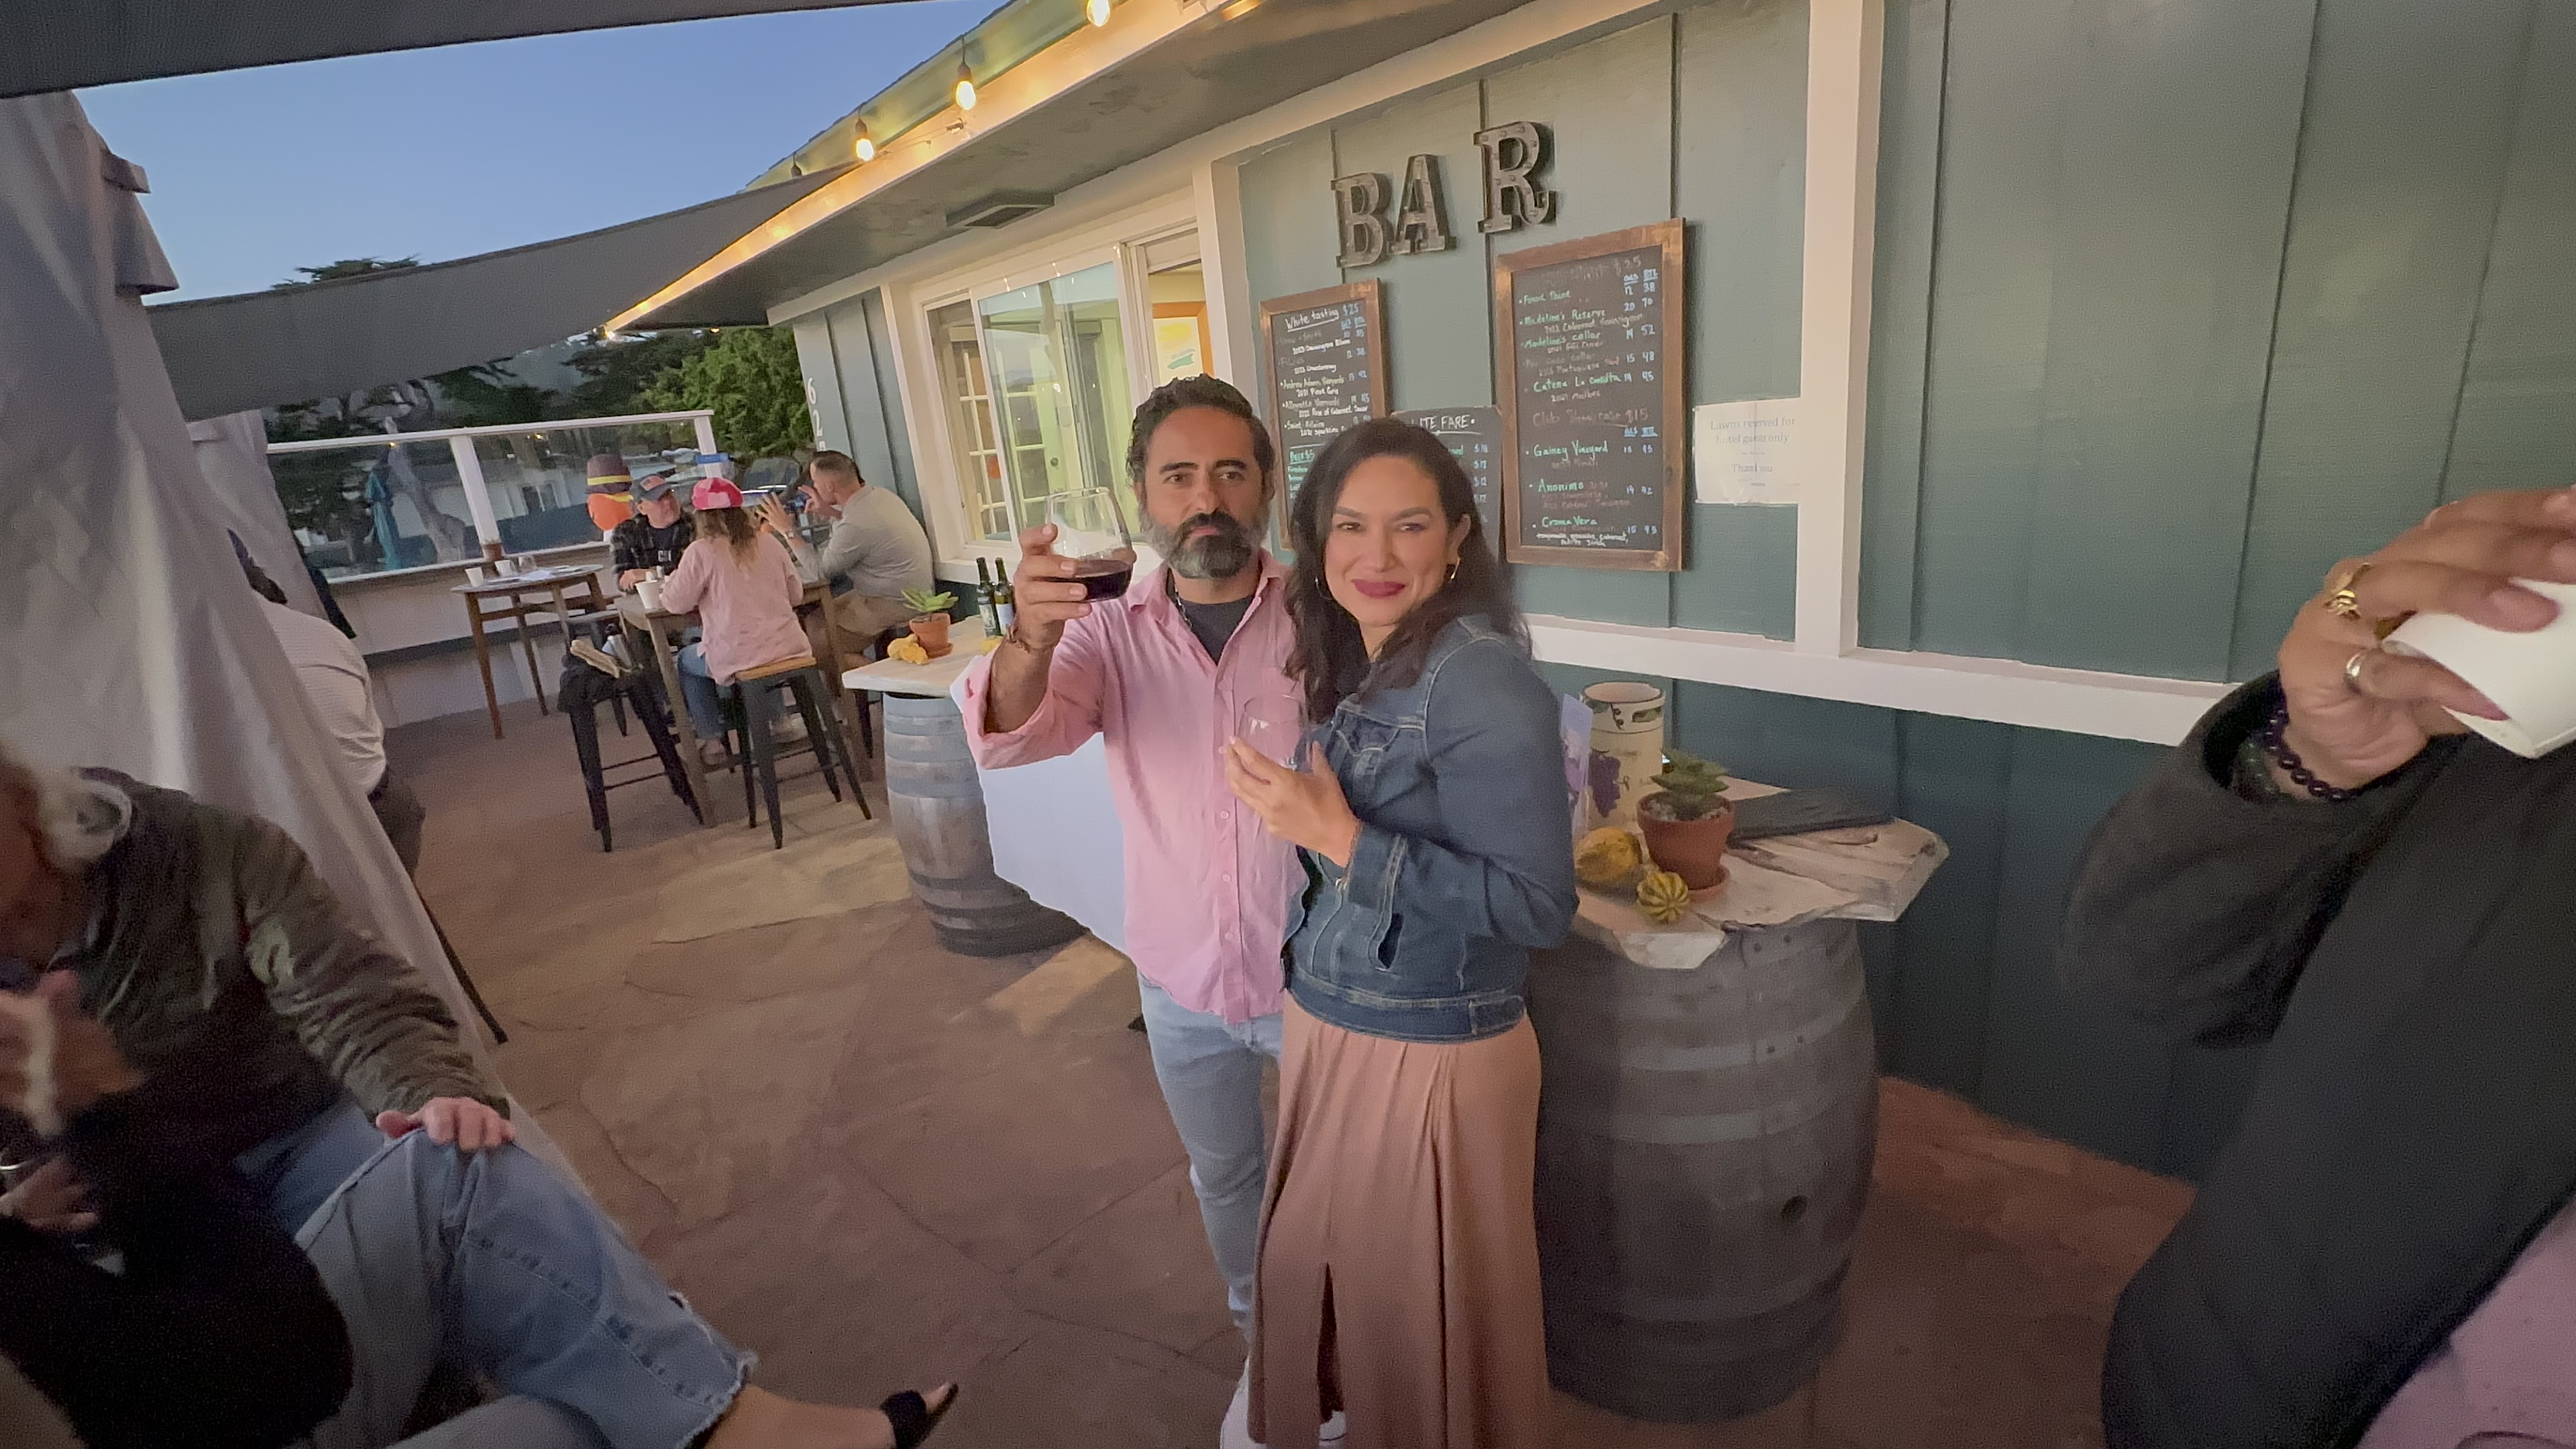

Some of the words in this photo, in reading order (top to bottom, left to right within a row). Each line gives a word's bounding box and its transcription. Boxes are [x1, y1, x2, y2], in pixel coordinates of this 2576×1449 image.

[1331, 121, 1557, 268] BAR
[1572, 309, 1605, 320] Reserve
[1624, 302, 1635, 311] 20
[1285, 314, 1309, 329] White
[1641, 324, 1656, 335] 52
[1642, 351, 1654, 362] 48
[1441, 415, 1470, 430] FARE
[1711, 421, 1741, 430] Lawns
[1781, 416, 1796, 426] for
[1716, 434, 1740, 443] hotel
[1768, 432, 1790, 444] only
[1573, 515, 1597, 526] Vera
